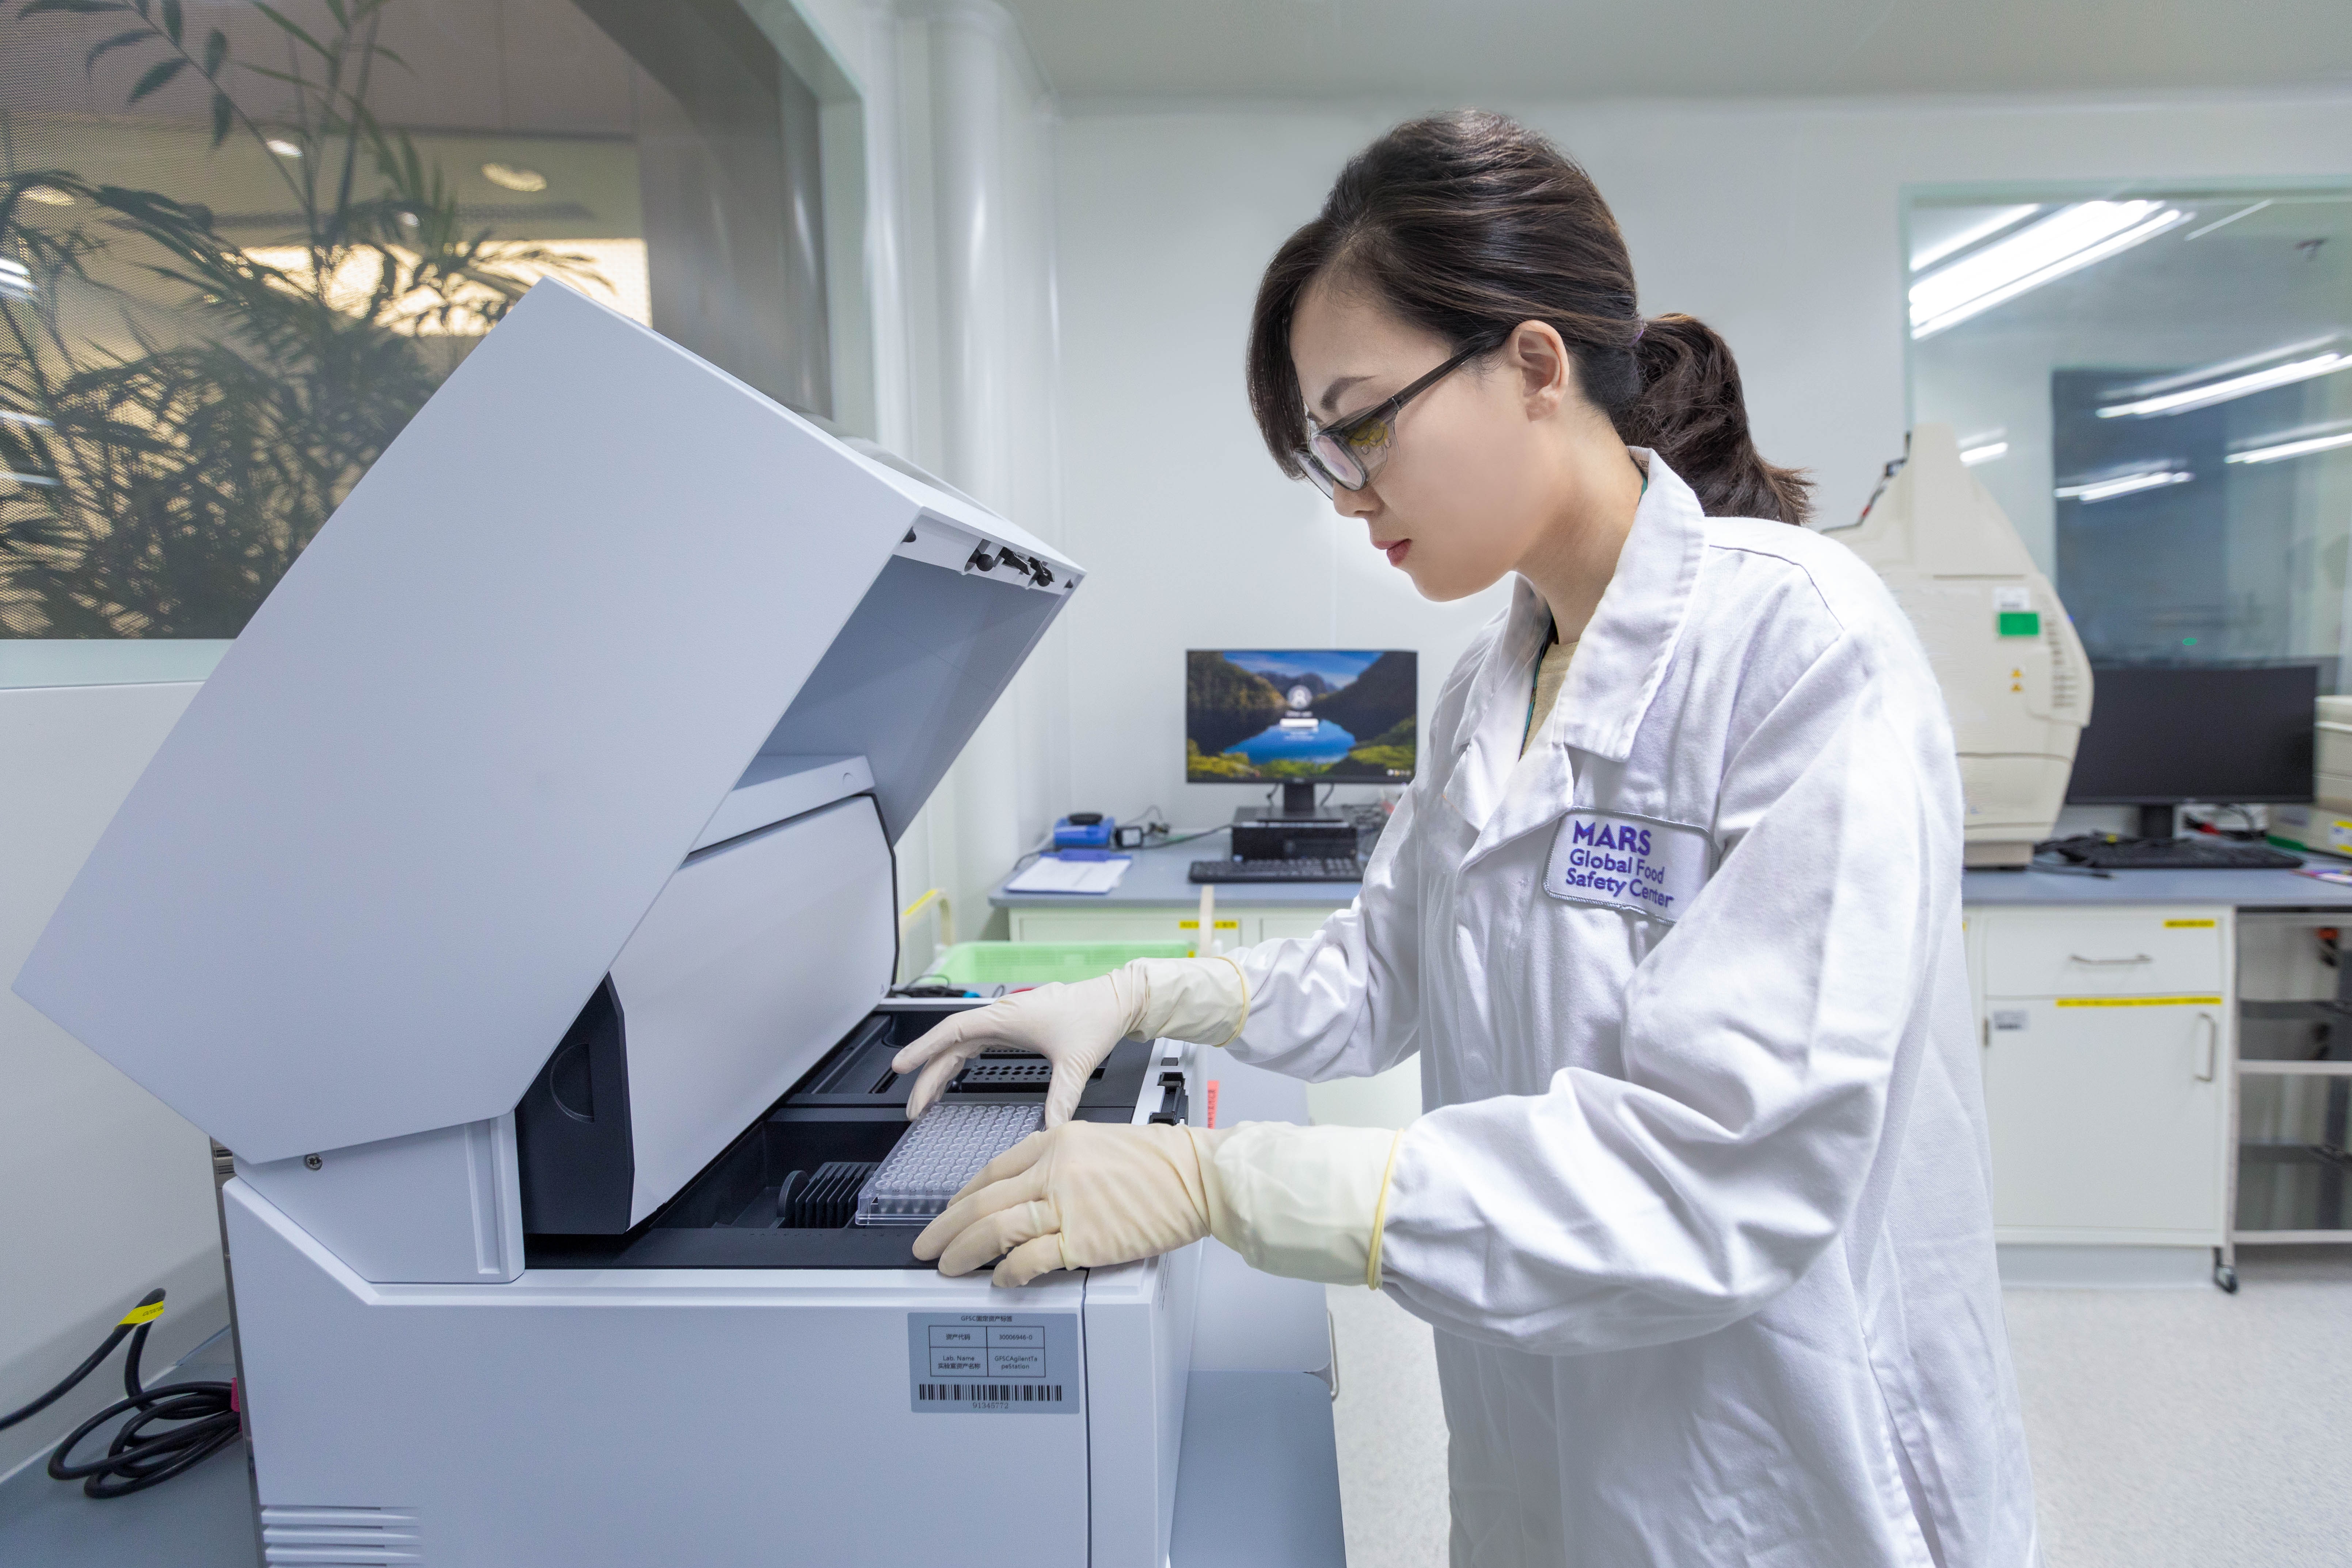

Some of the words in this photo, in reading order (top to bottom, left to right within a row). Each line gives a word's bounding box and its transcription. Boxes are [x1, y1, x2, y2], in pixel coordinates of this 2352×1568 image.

[1573, 820, 1652, 856] MARS
[1570, 848, 1633, 874] Global
[1637, 859, 1665, 884] Food
[1566, 867, 1626, 897] Safety
[1630, 879, 1675, 908] Center
